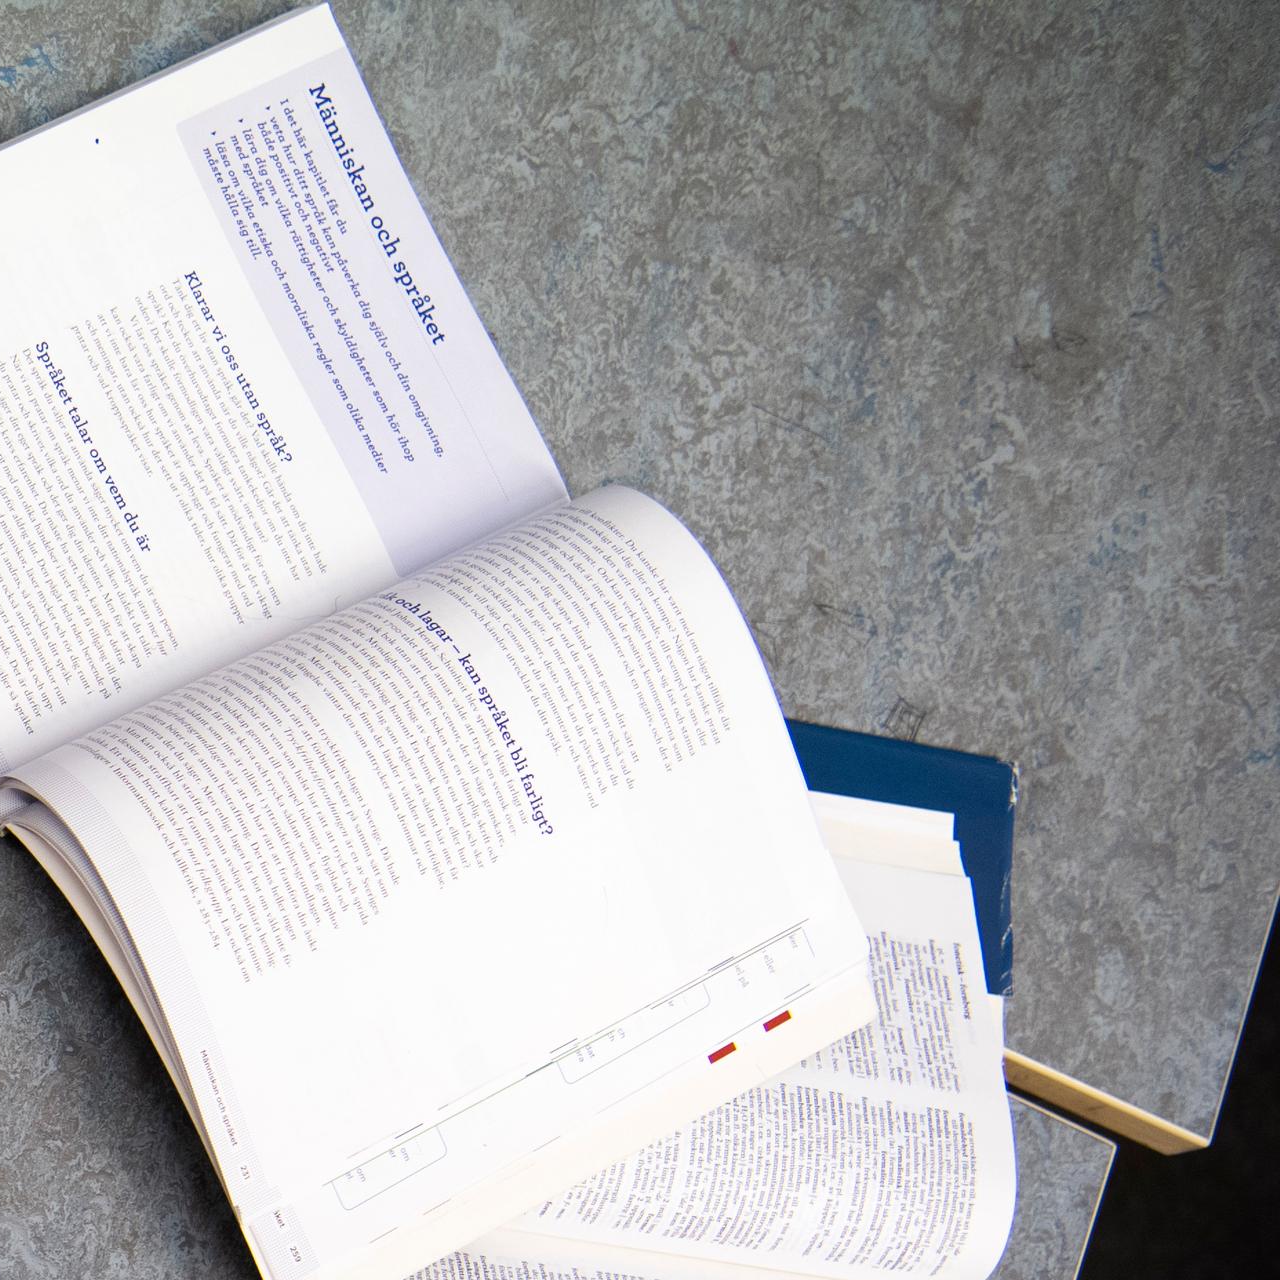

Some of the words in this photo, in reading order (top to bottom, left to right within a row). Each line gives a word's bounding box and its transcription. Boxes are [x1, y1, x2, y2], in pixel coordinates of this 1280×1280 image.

[279, 98, 289, 106] I
[283, 107, 297, 128] det
[292, 127, 307, 149] här
[202, 147, 224, 184] måste
[220, 184, 240, 218] hålla
[236, 219, 250, 238] sig
[245, 238, 263, 261] till.
[230, 135, 250, 161] med
[242, 162, 269, 207] språket
[256, 121, 276, 152] både
[268, 153, 299, 199] positivt
[294, 201, 311, 223] och
[304, 223, 335, 273] negativt
[303, 149, 331, 199] kapitlet
[308, 82, 375, 213] Människan
[370, 215, 401, 258] och
[393, 261, 446, 346] språket
[326, 198, 340, 217] får
[335, 219, 348, 235] du
[214, 140, 231, 168] läsa
[227, 169, 241, 188] om
[237, 189, 256, 220] vilka
[252, 221, 274, 258] etiska
[270, 259, 288, 281] och
[281, 282, 316, 341] moraliska
[312, 341, 336, 376] regler
[332, 378, 349, 402] som
[345, 402, 366, 433] olika
[362, 433, 388, 474] medier
[241, 128, 258, 155] lära
[254, 156, 269, 177] dig
[264, 178, 278, 197] om
[274, 197, 293, 228] vilka
[289, 229, 326, 294] rättigheter
[322, 295, 339, 317] och
[333, 317, 377, 388] skyldigheter
[372, 390, 389, 414] som
[385, 413, 401, 435] hör
[397, 436, 415, 462] ihop
[269, 116, 286, 144] veta
[281, 143, 297, 166] hur
[292, 168, 309, 191] ditt
[304, 192, 327, 226] språk
[320, 226, 336, 250] kan
[330, 251, 362, 299] påverka
[358, 300, 373, 320] dig
[368, 320, 389, 349] själv
[384, 350, 402, 372] och
[396, 372, 411, 393] din
[408, 393, 444, 458] omgivning,
[183, 270, 216, 322] Klarar
[212, 325, 228, 343] vi
[221, 345, 239, 372] oss
[236, 372, 260, 411] utan
[256, 412, 293, 462] språk?
[35, 341, 73, 406] Språket
[68, 406, 93, 444] talar
[89, 448, 107, 475] om
[104, 474, 127, 511] vem
[123, 512, 140, 534] du
[135, 534, 151, 552] är
[394, 598, 422, 615] och
[417, 610, 454, 643] lagar
[457, 653, 481, 686] kan
[477, 686, 516, 749] språket
[509, 746, 529, 773] bli
[520, 773, 554, 835] farligt?
